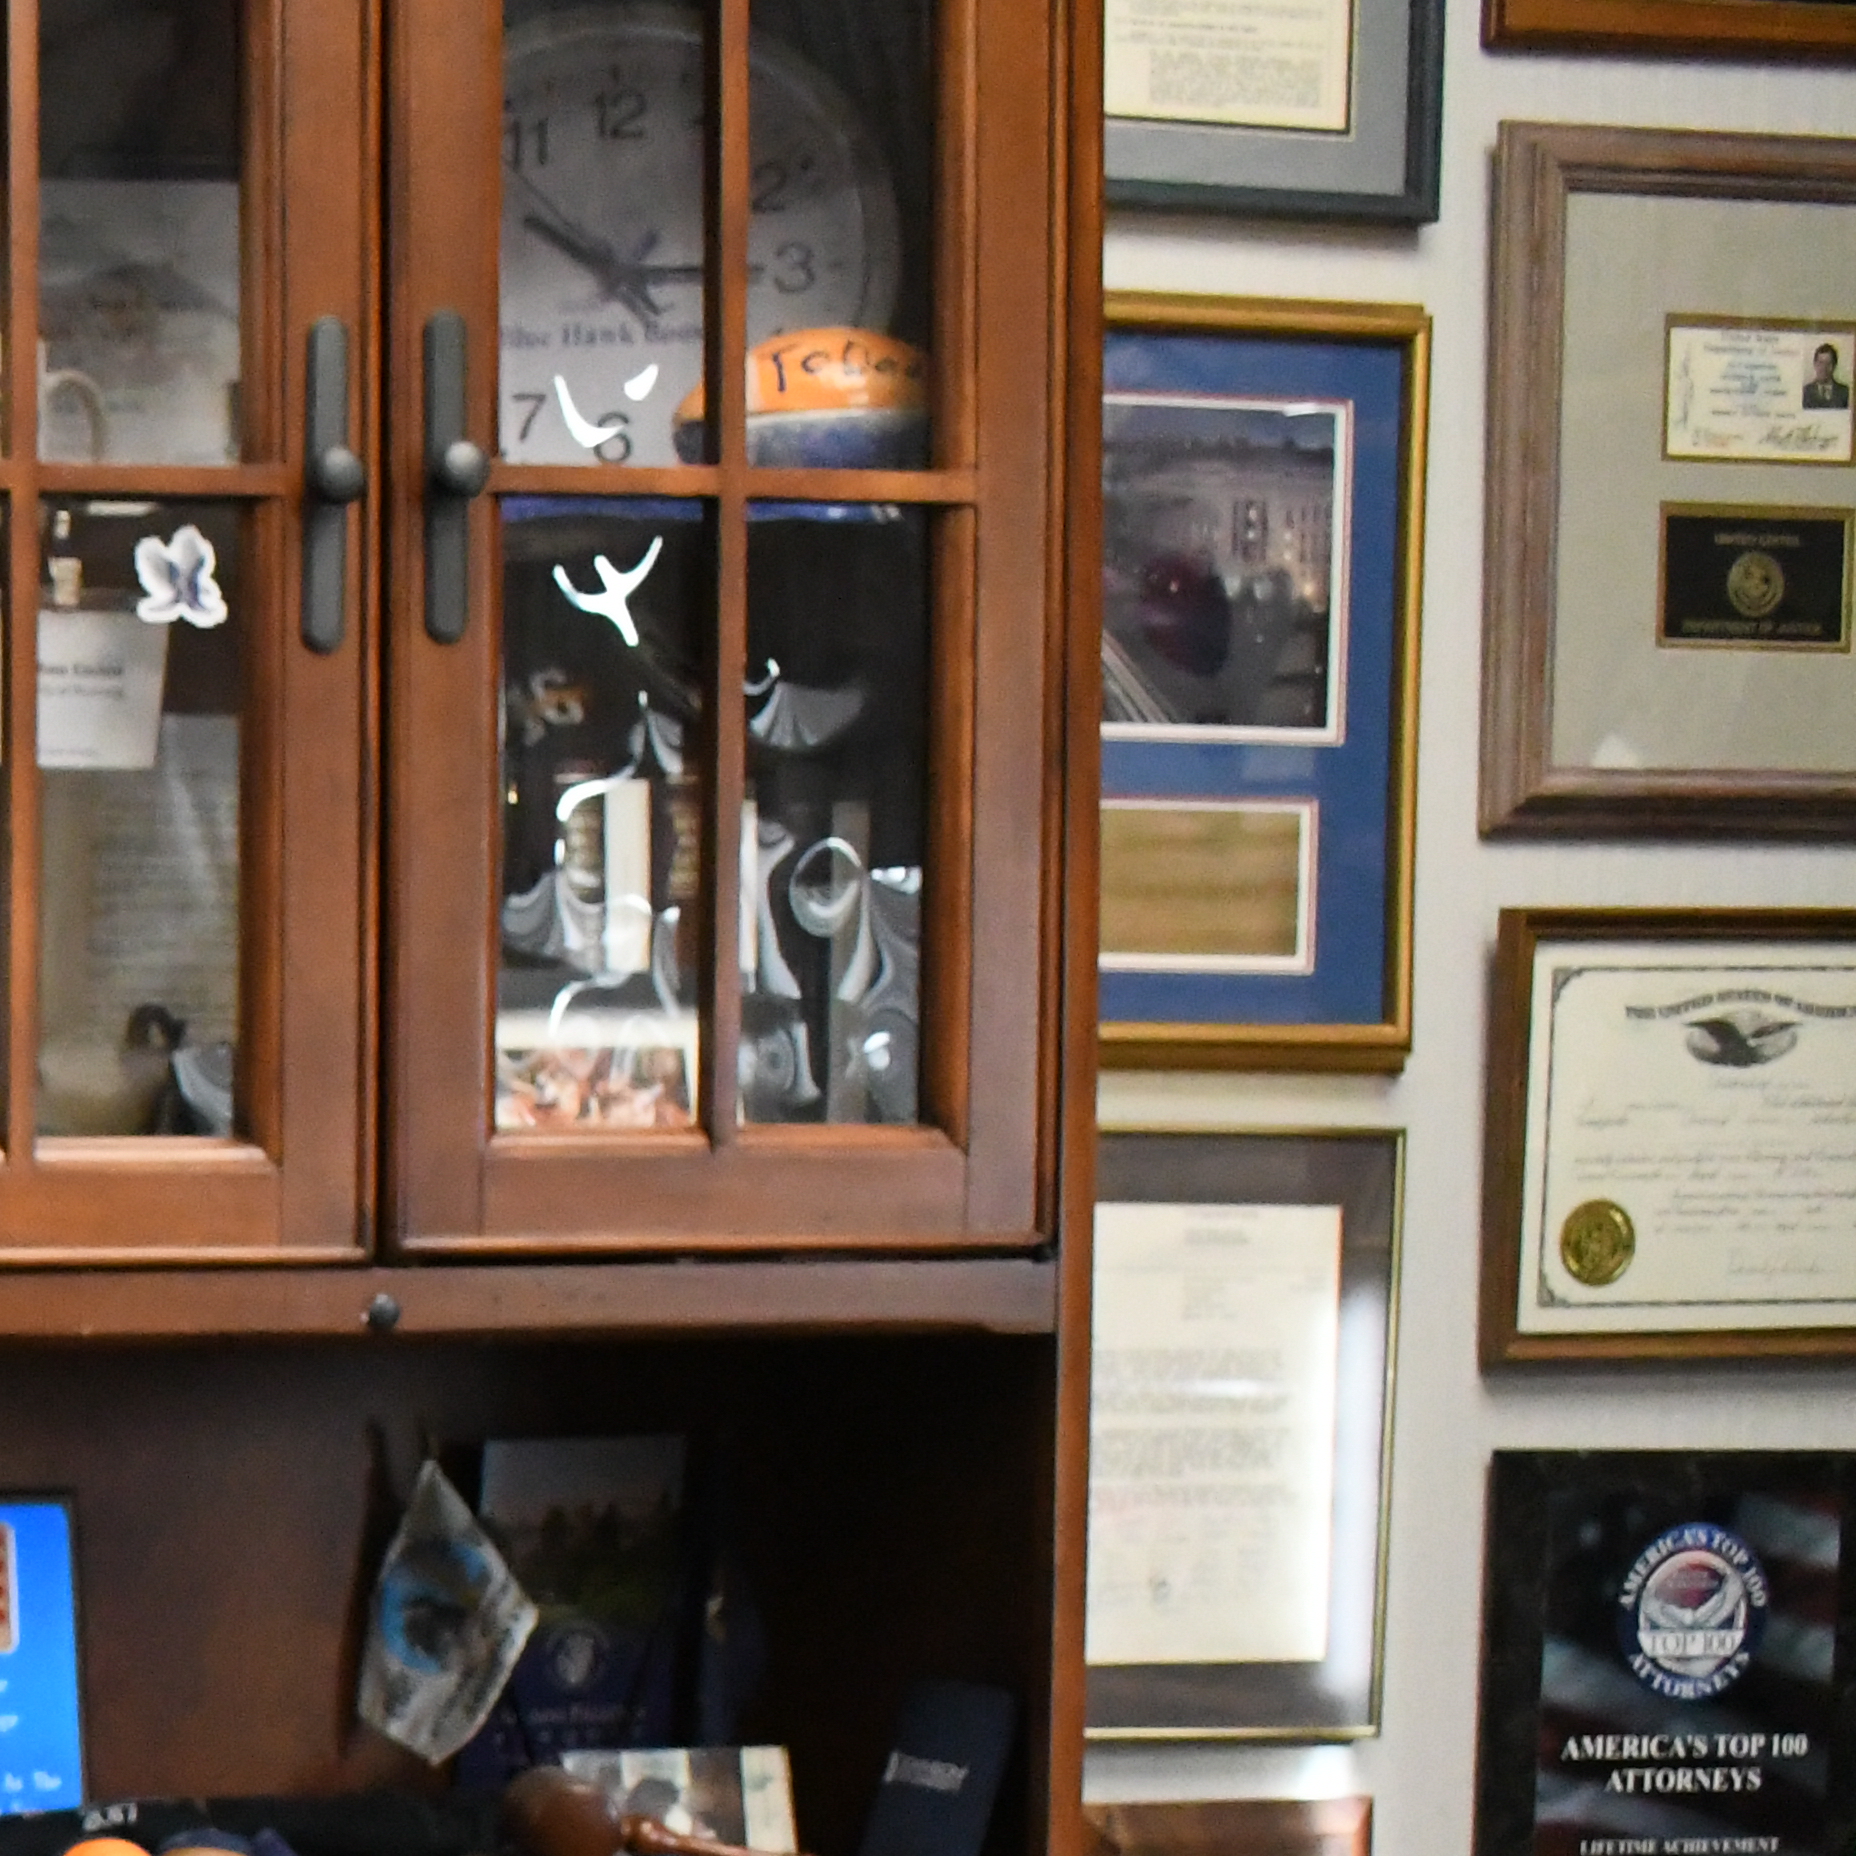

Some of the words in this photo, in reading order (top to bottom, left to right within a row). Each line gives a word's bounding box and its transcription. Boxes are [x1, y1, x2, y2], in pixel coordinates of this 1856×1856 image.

[595, 90, 648, 140] 12
[773, 241, 816, 295] 3
[512, 393, 547, 442] 7
[1629, 1652, 1750, 1701] ATTORNEYS
[1560, 1732, 1708, 1761] AMERICA'S
[1713, 1732, 1767, 1759] TOP
[1772, 1732, 1809, 1759] 100
[1605, 1767, 1763, 1794] ATTORNEYS
